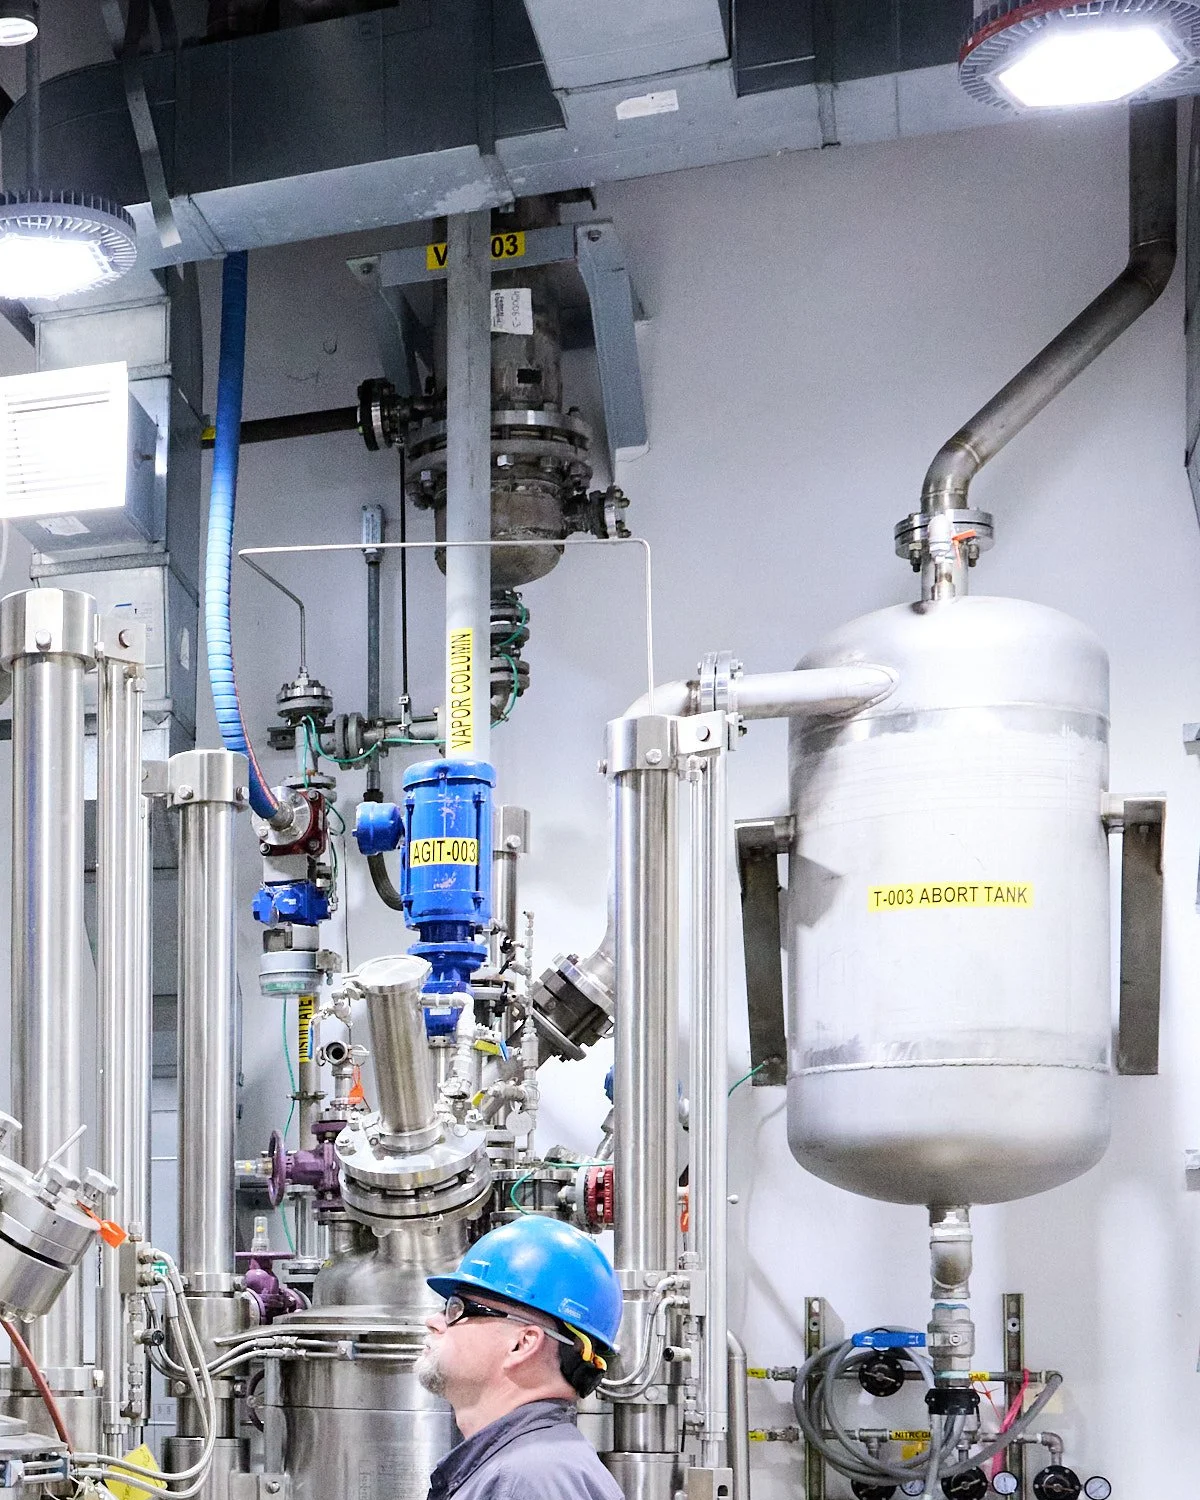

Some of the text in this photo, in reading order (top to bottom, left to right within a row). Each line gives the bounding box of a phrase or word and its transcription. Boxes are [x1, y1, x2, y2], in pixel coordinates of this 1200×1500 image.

[451, 633, 472, 749] VAPOR COLUMN
[413, 840, 476, 865] AGIT-003
[874, 886, 1027, 906] T-003 ABORT TANK
